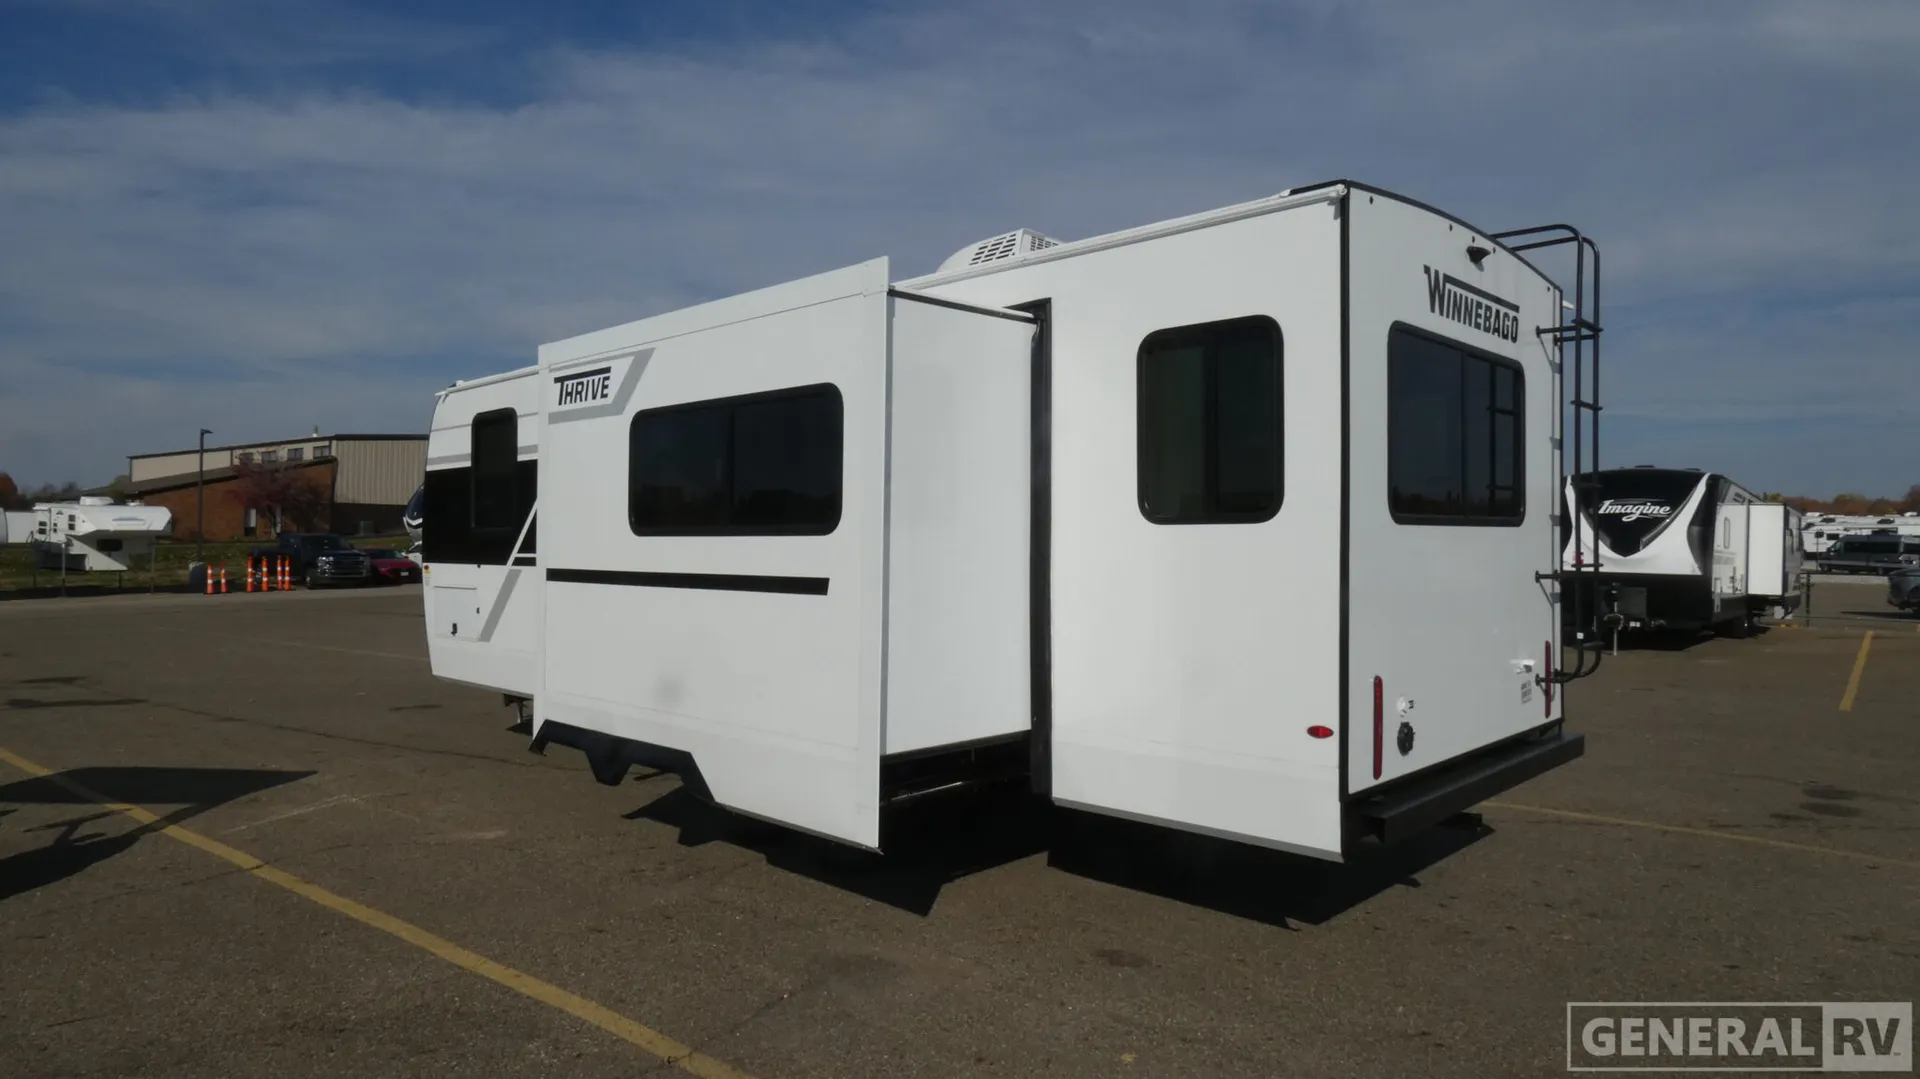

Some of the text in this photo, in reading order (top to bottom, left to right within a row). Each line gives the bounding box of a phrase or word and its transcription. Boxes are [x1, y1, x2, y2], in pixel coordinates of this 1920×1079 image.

[1423, 264, 1519, 343] WINNEBAGO
[554, 366, 611, 405] THRIVE
[1598, 500, 1672, 521] Imagine
